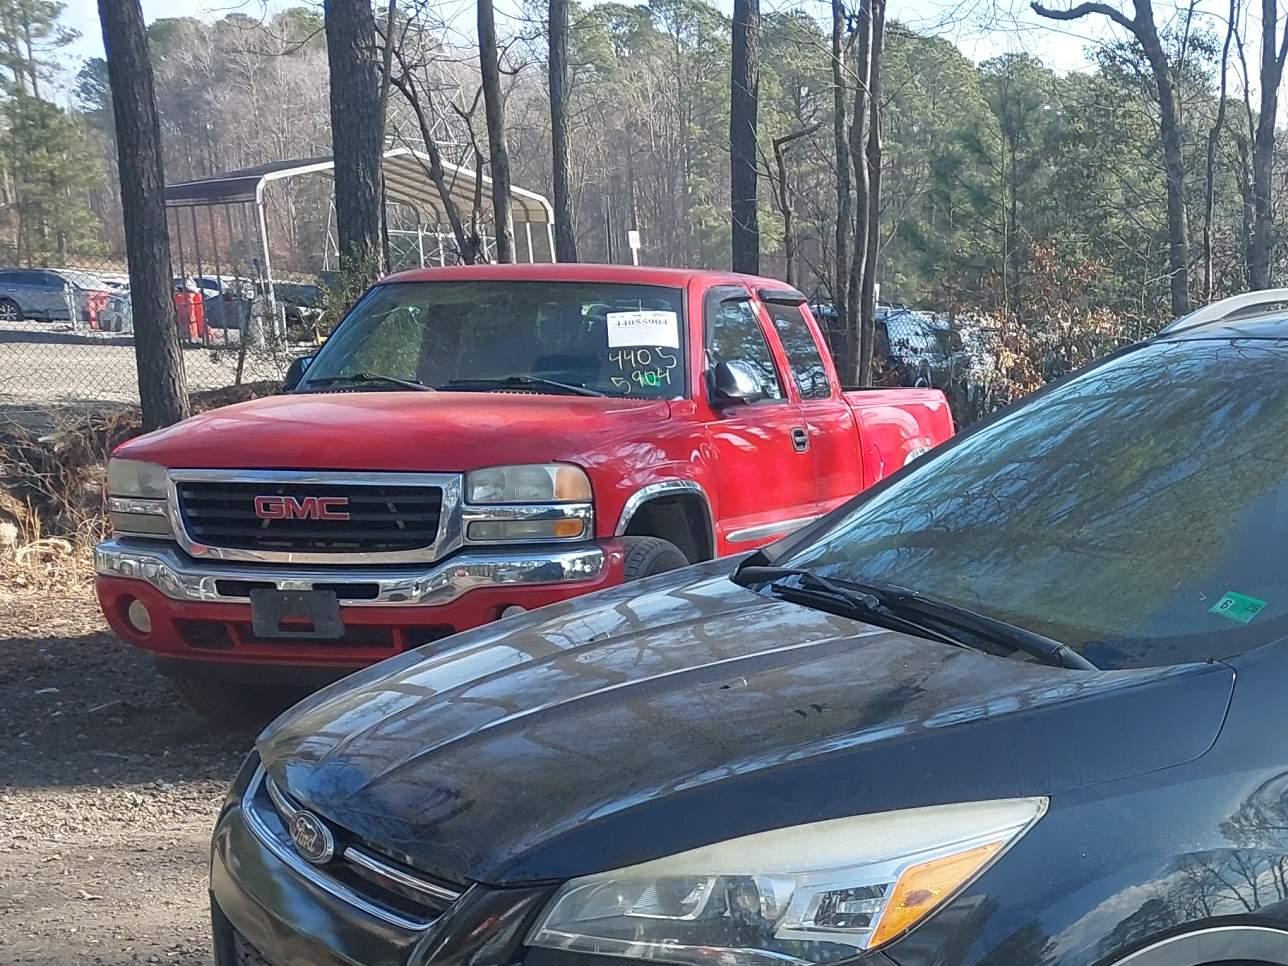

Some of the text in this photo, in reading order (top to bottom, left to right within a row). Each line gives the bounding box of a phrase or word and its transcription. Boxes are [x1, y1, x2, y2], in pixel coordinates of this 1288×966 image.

[608, 346, 677, 370] 4405
[610, 367, 671, 394] 5904
[254, 495, 351, 520] GMC
[1220, 599, 1233, 609] 6
[293, 816, 318, 853] Ford
